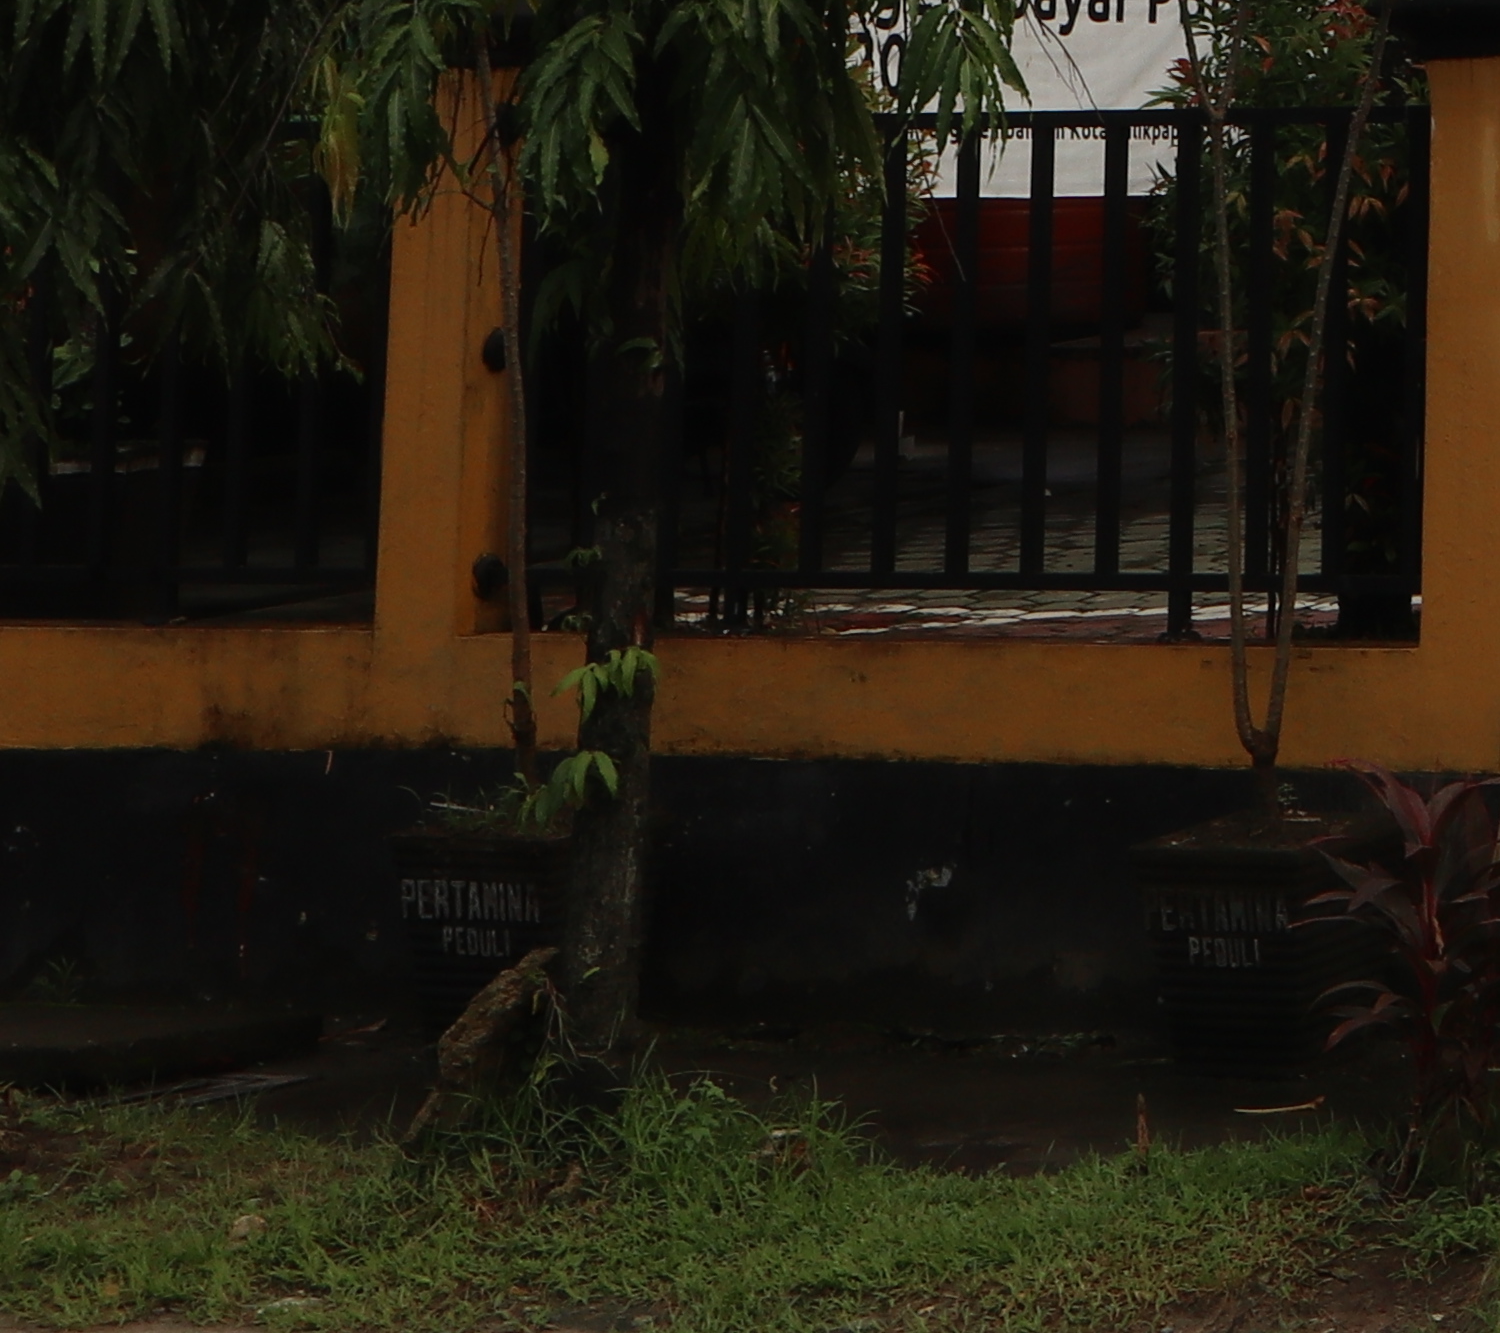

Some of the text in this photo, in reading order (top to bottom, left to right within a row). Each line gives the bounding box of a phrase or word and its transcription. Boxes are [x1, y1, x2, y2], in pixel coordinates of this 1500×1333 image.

[399, 877, 540, 924] PERTAMINA
[1143, 887, 1291, 935] PERTAMINA
[441, 926, 513, 958] PEDULI
[1188, 935, 1262, 968] PEDULI
